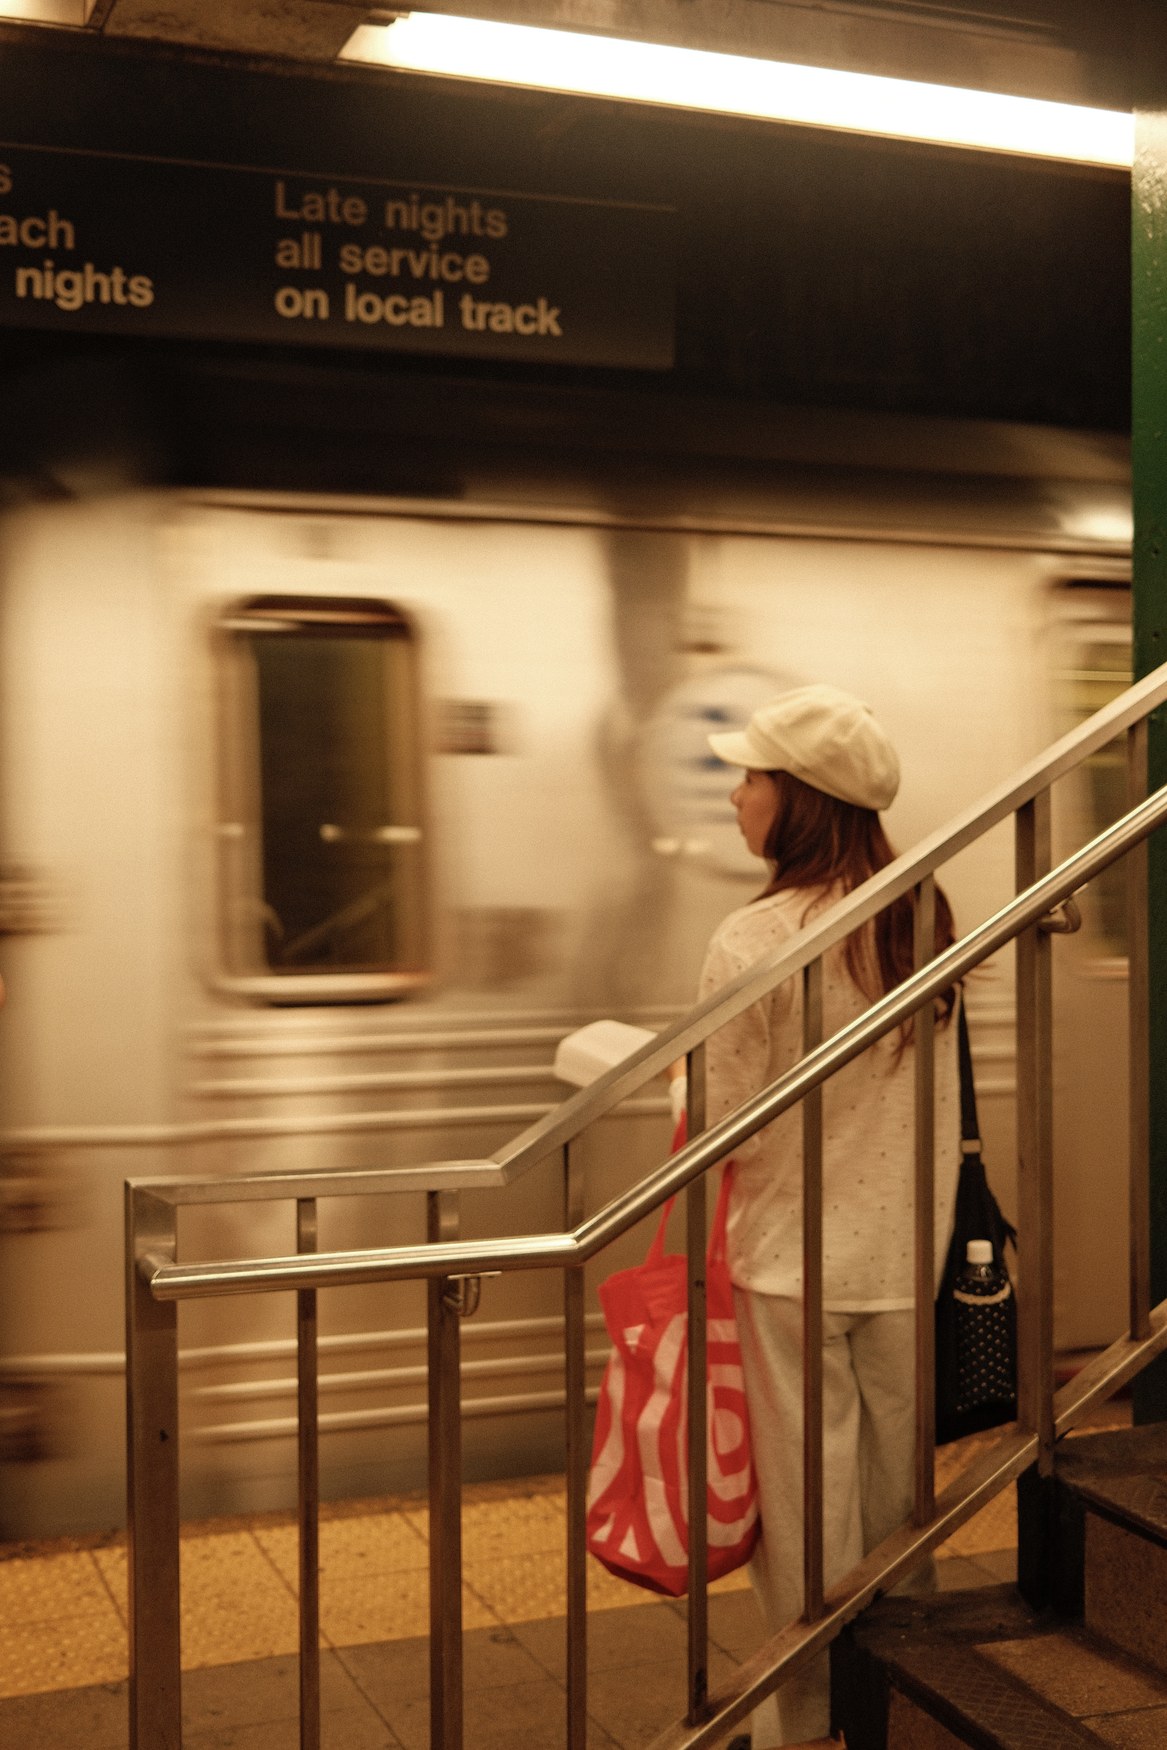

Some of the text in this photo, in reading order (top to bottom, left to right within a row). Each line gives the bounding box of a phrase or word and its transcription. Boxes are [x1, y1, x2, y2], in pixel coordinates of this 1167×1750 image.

[275, 181, 509, 240] Late nights
[275, 232, 491, 284] all service
[15, 259, 155, 311] nights
[275, 283, 563, 336] on local track
